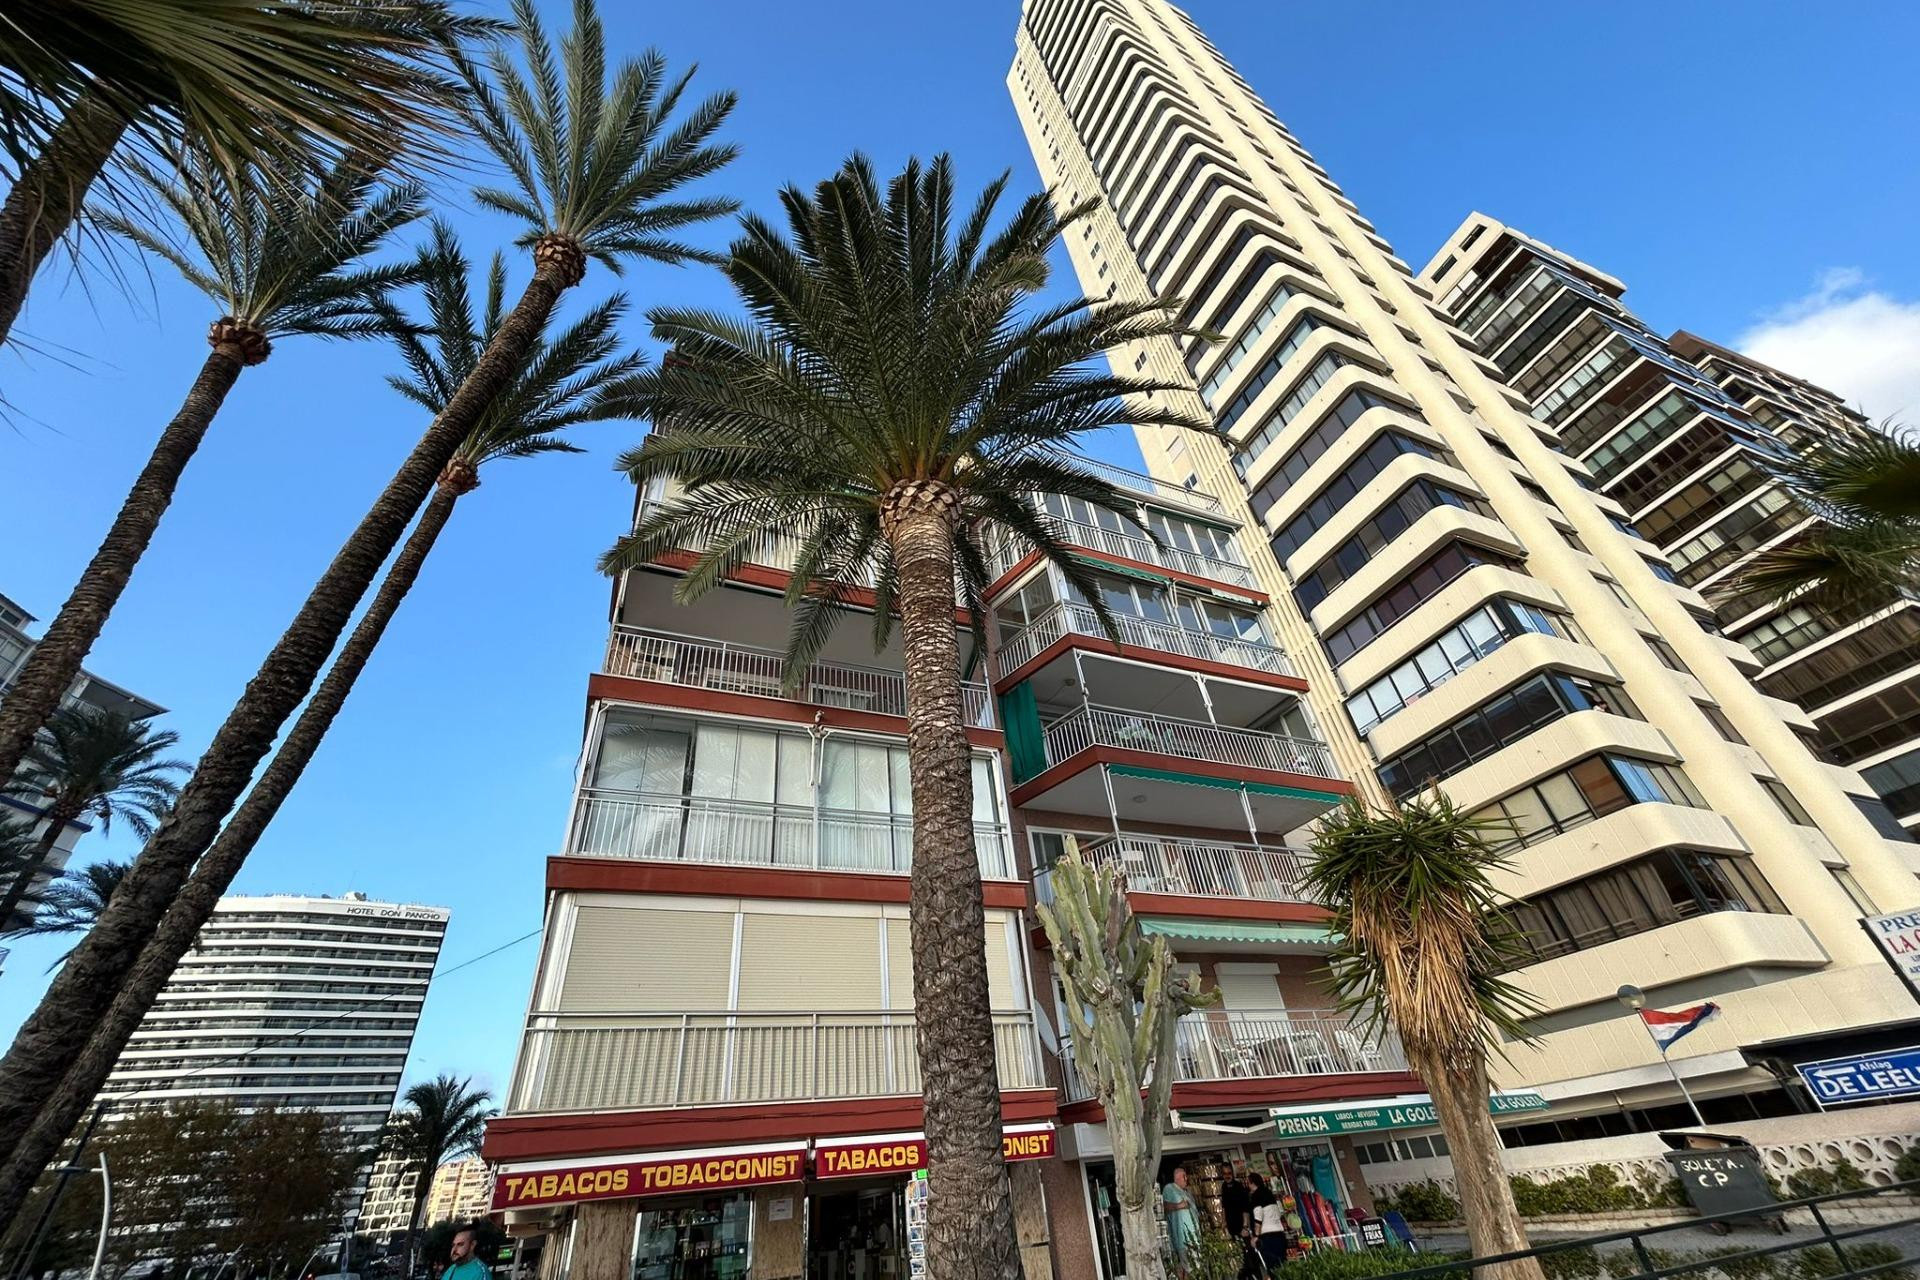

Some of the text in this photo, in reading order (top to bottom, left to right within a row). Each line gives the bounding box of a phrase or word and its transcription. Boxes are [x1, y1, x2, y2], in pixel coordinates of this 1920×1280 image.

[347, 907, 440, 920] HOTEL DON PANCHO
[1885, 935, 1918, 954] LA
[1858, 1060, 1893, 1072] Afslag
[1817, 1076, 1859, 1096] DE
[1492, 1096, 1546, 1109] LA GOLETA
[1278, 1115, 1329, 1135] PRENSA
[1334, 1112, 1354, 1121] LIBROS
[1388, 1109, 1406, 1124] LA
[825, 1146, 919, 1171] TABACOS
[505, 1155, 799, 1200] TABACOS TOBACCONIST
